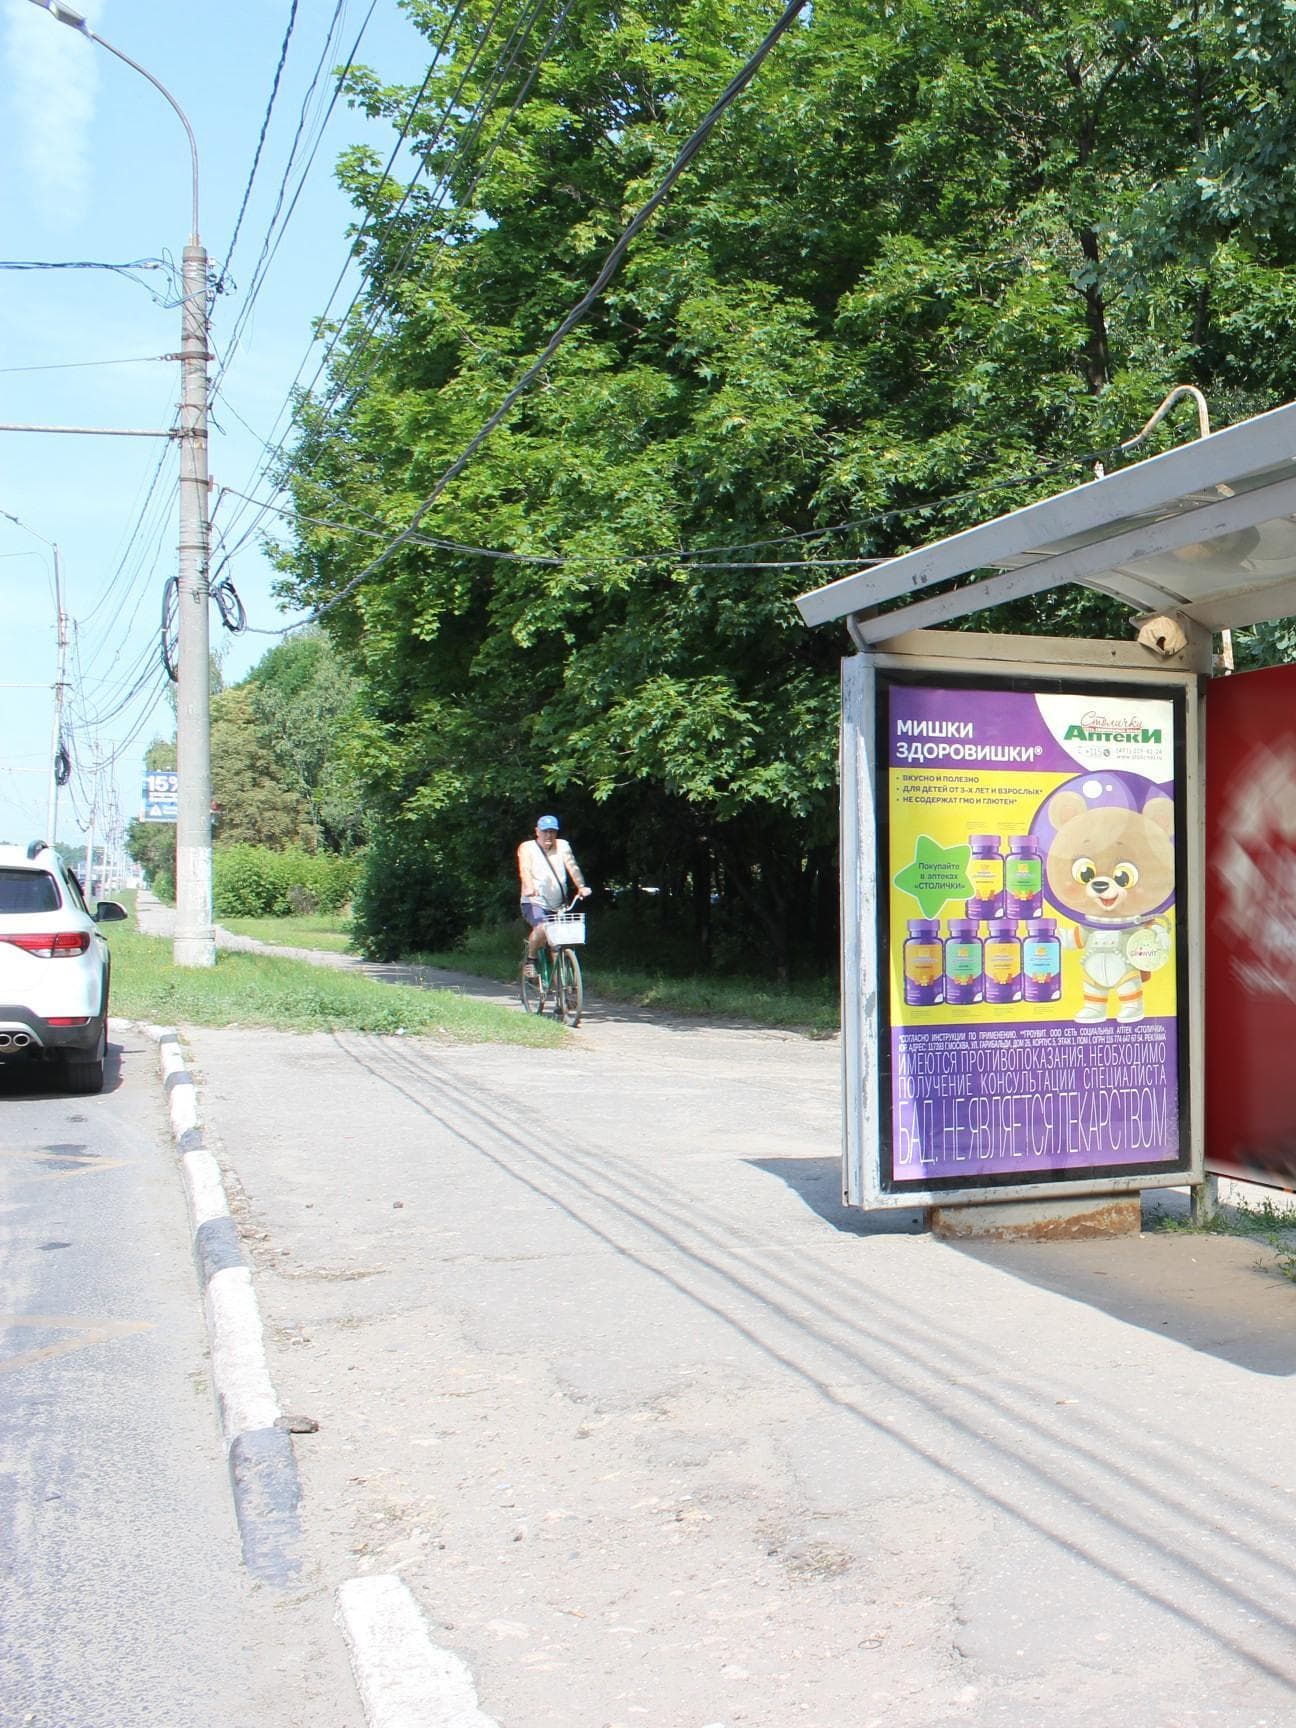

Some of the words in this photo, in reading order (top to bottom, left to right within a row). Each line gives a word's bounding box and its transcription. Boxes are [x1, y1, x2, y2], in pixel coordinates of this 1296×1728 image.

[896, 719, 974, 739] МИШКИ
[902, 774, 935, 783] ВКУСНО
[936, 775, 942, 783] И
[942, 775, 980, 784] ПОЛЕЗНО
[902, 785, 921, 794] ДЛЯ
[921, 784, 948, 794] ДЕТЕЙ
[948, 786, 960, 794] ОТ
[974, 787, 990, 795] ЛЕТ
[990, 787, 997, 795] И
[902, 796, 914, 804] НЕ
[914, 796, 958, 805] СОДЕРЖАТ
[959, 797, 975, 805] ГМО
[975, 797, 982, 805] И
[918, 862, 960, 872] Покупайте
[927, 873, 958, 881] аптеках
[914, 881, 966, 891] «СТОЛИЧКИ»
[968, 1031, 977, 1041] ПО
[1116, 1025, 1132, 1034] АПТЕК
[898, 1050, 957, 1076] ИМЕЮТСЯ
[960, 1045, 1087, 1074] ПРОТИВОПОКАЗАНИЯ.
[1089, 1041, 1166, 1067] НЕОБХОДИМО
[898, 1073, 973, 1099] ПОЛУЧЕНИЕ
[980, 1068, 1076, 1095] КОНСУЛЬТАЦИИ
[1083, 1064, 1167, 1090] СПЕЦИАЛИСТА
[943, 1097, 966, 1161] НЕ
[968, 1093, 1054, 1160] ЯВЛЯЕТСЯ
[1056, 1087, 1167, 1154] ЛЕКАРСТВОМ
